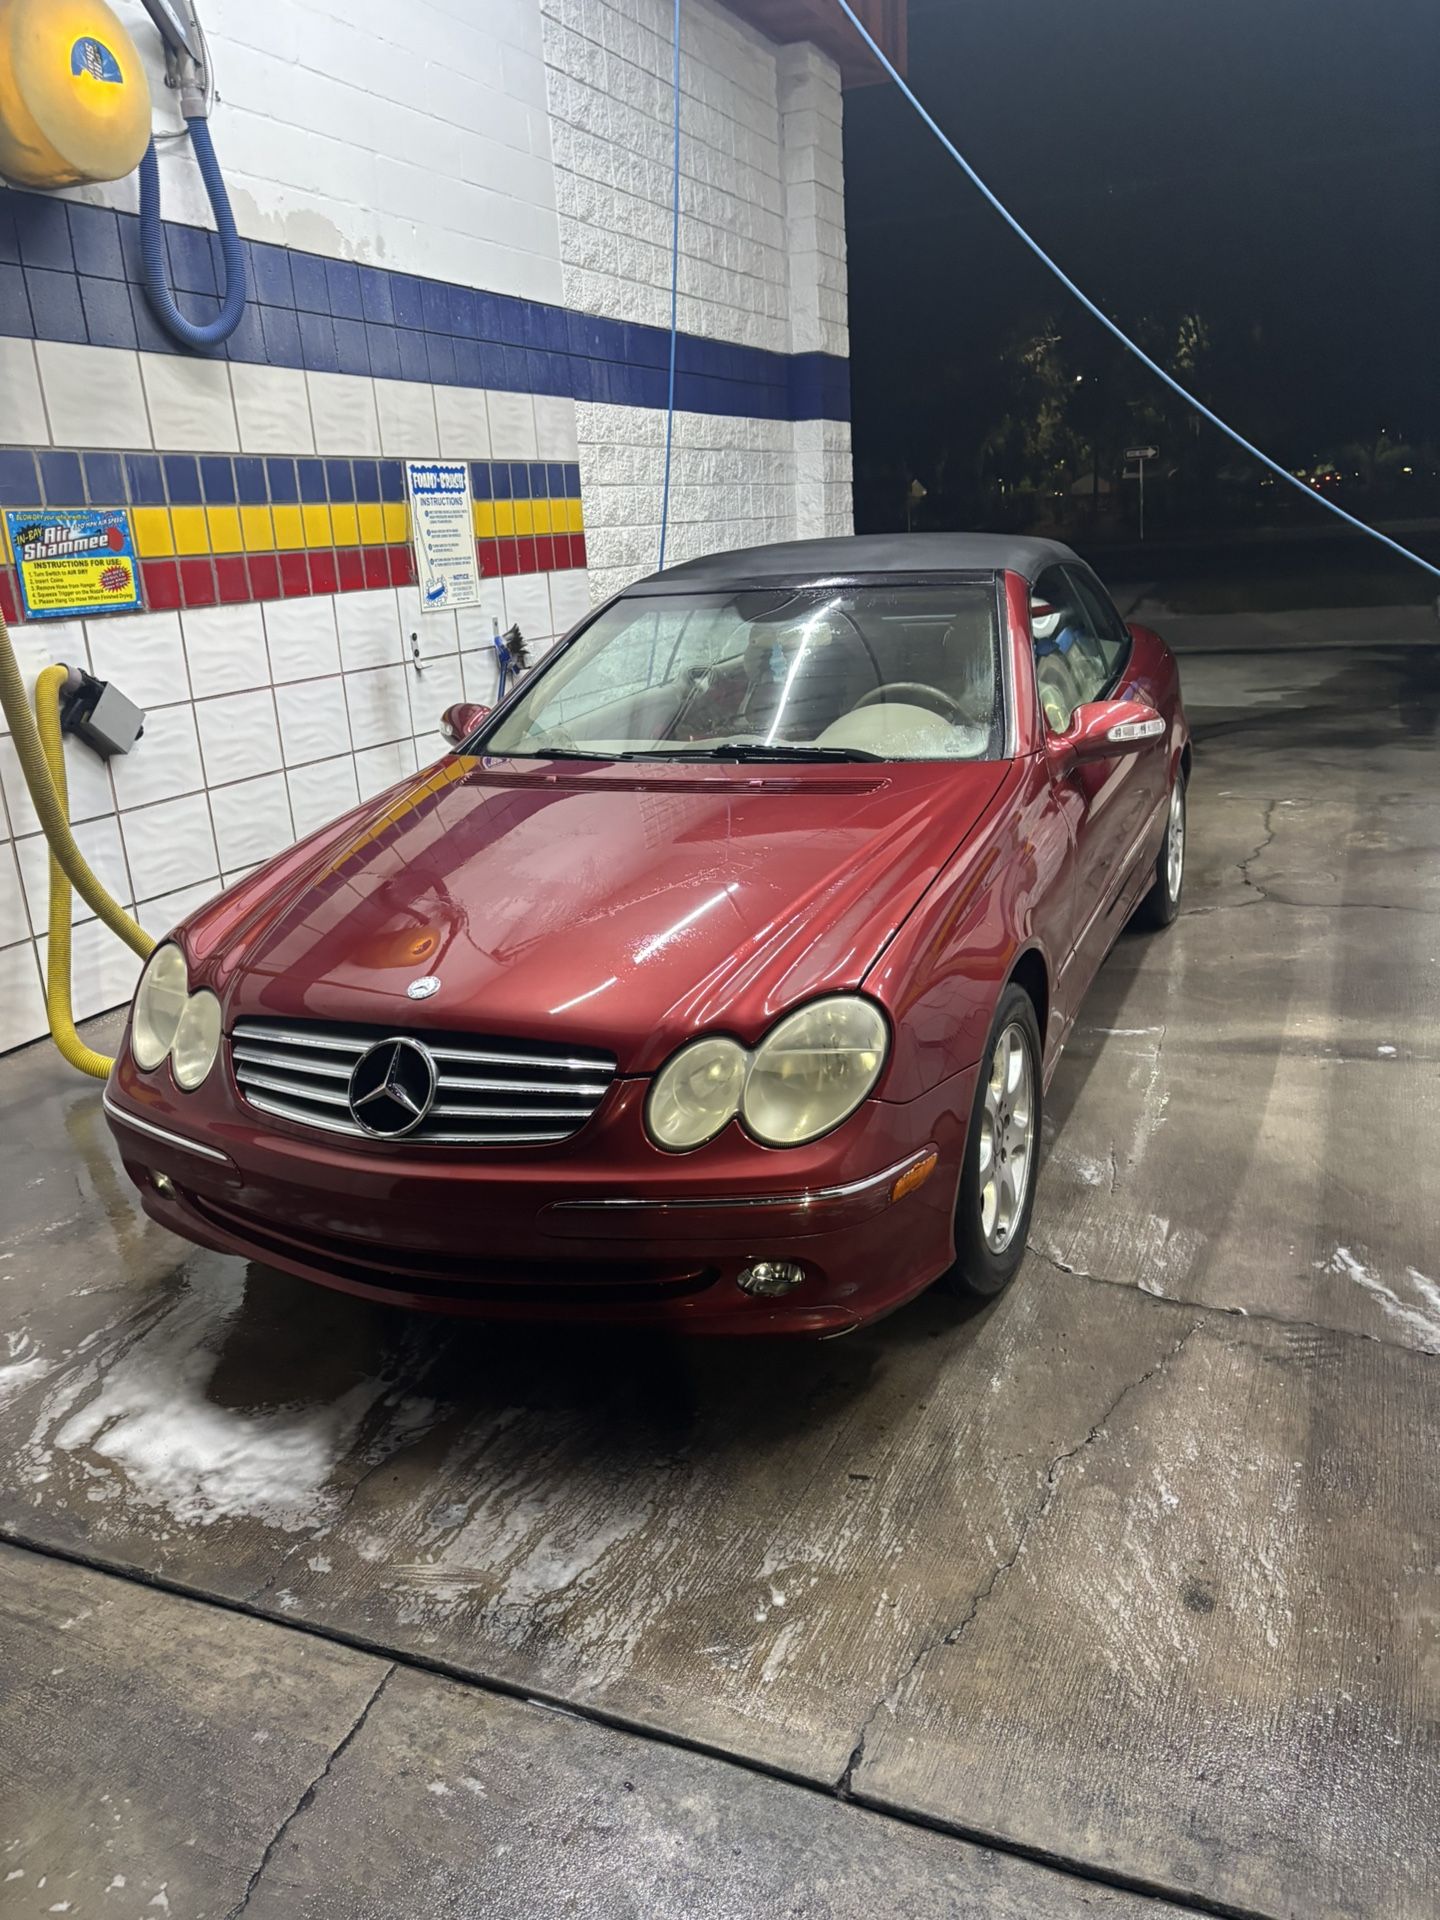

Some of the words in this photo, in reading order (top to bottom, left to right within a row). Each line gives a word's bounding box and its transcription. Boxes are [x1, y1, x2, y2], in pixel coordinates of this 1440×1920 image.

[420, 496, 464, 506] INSTRUCTIONS
[16, 527, 43, 545] IN-BAY
[44, 526, 70, 544] Air
[24, 534, 109, 561] Shammee
[34, 559, 89, 569] INSTRUCTIONS
